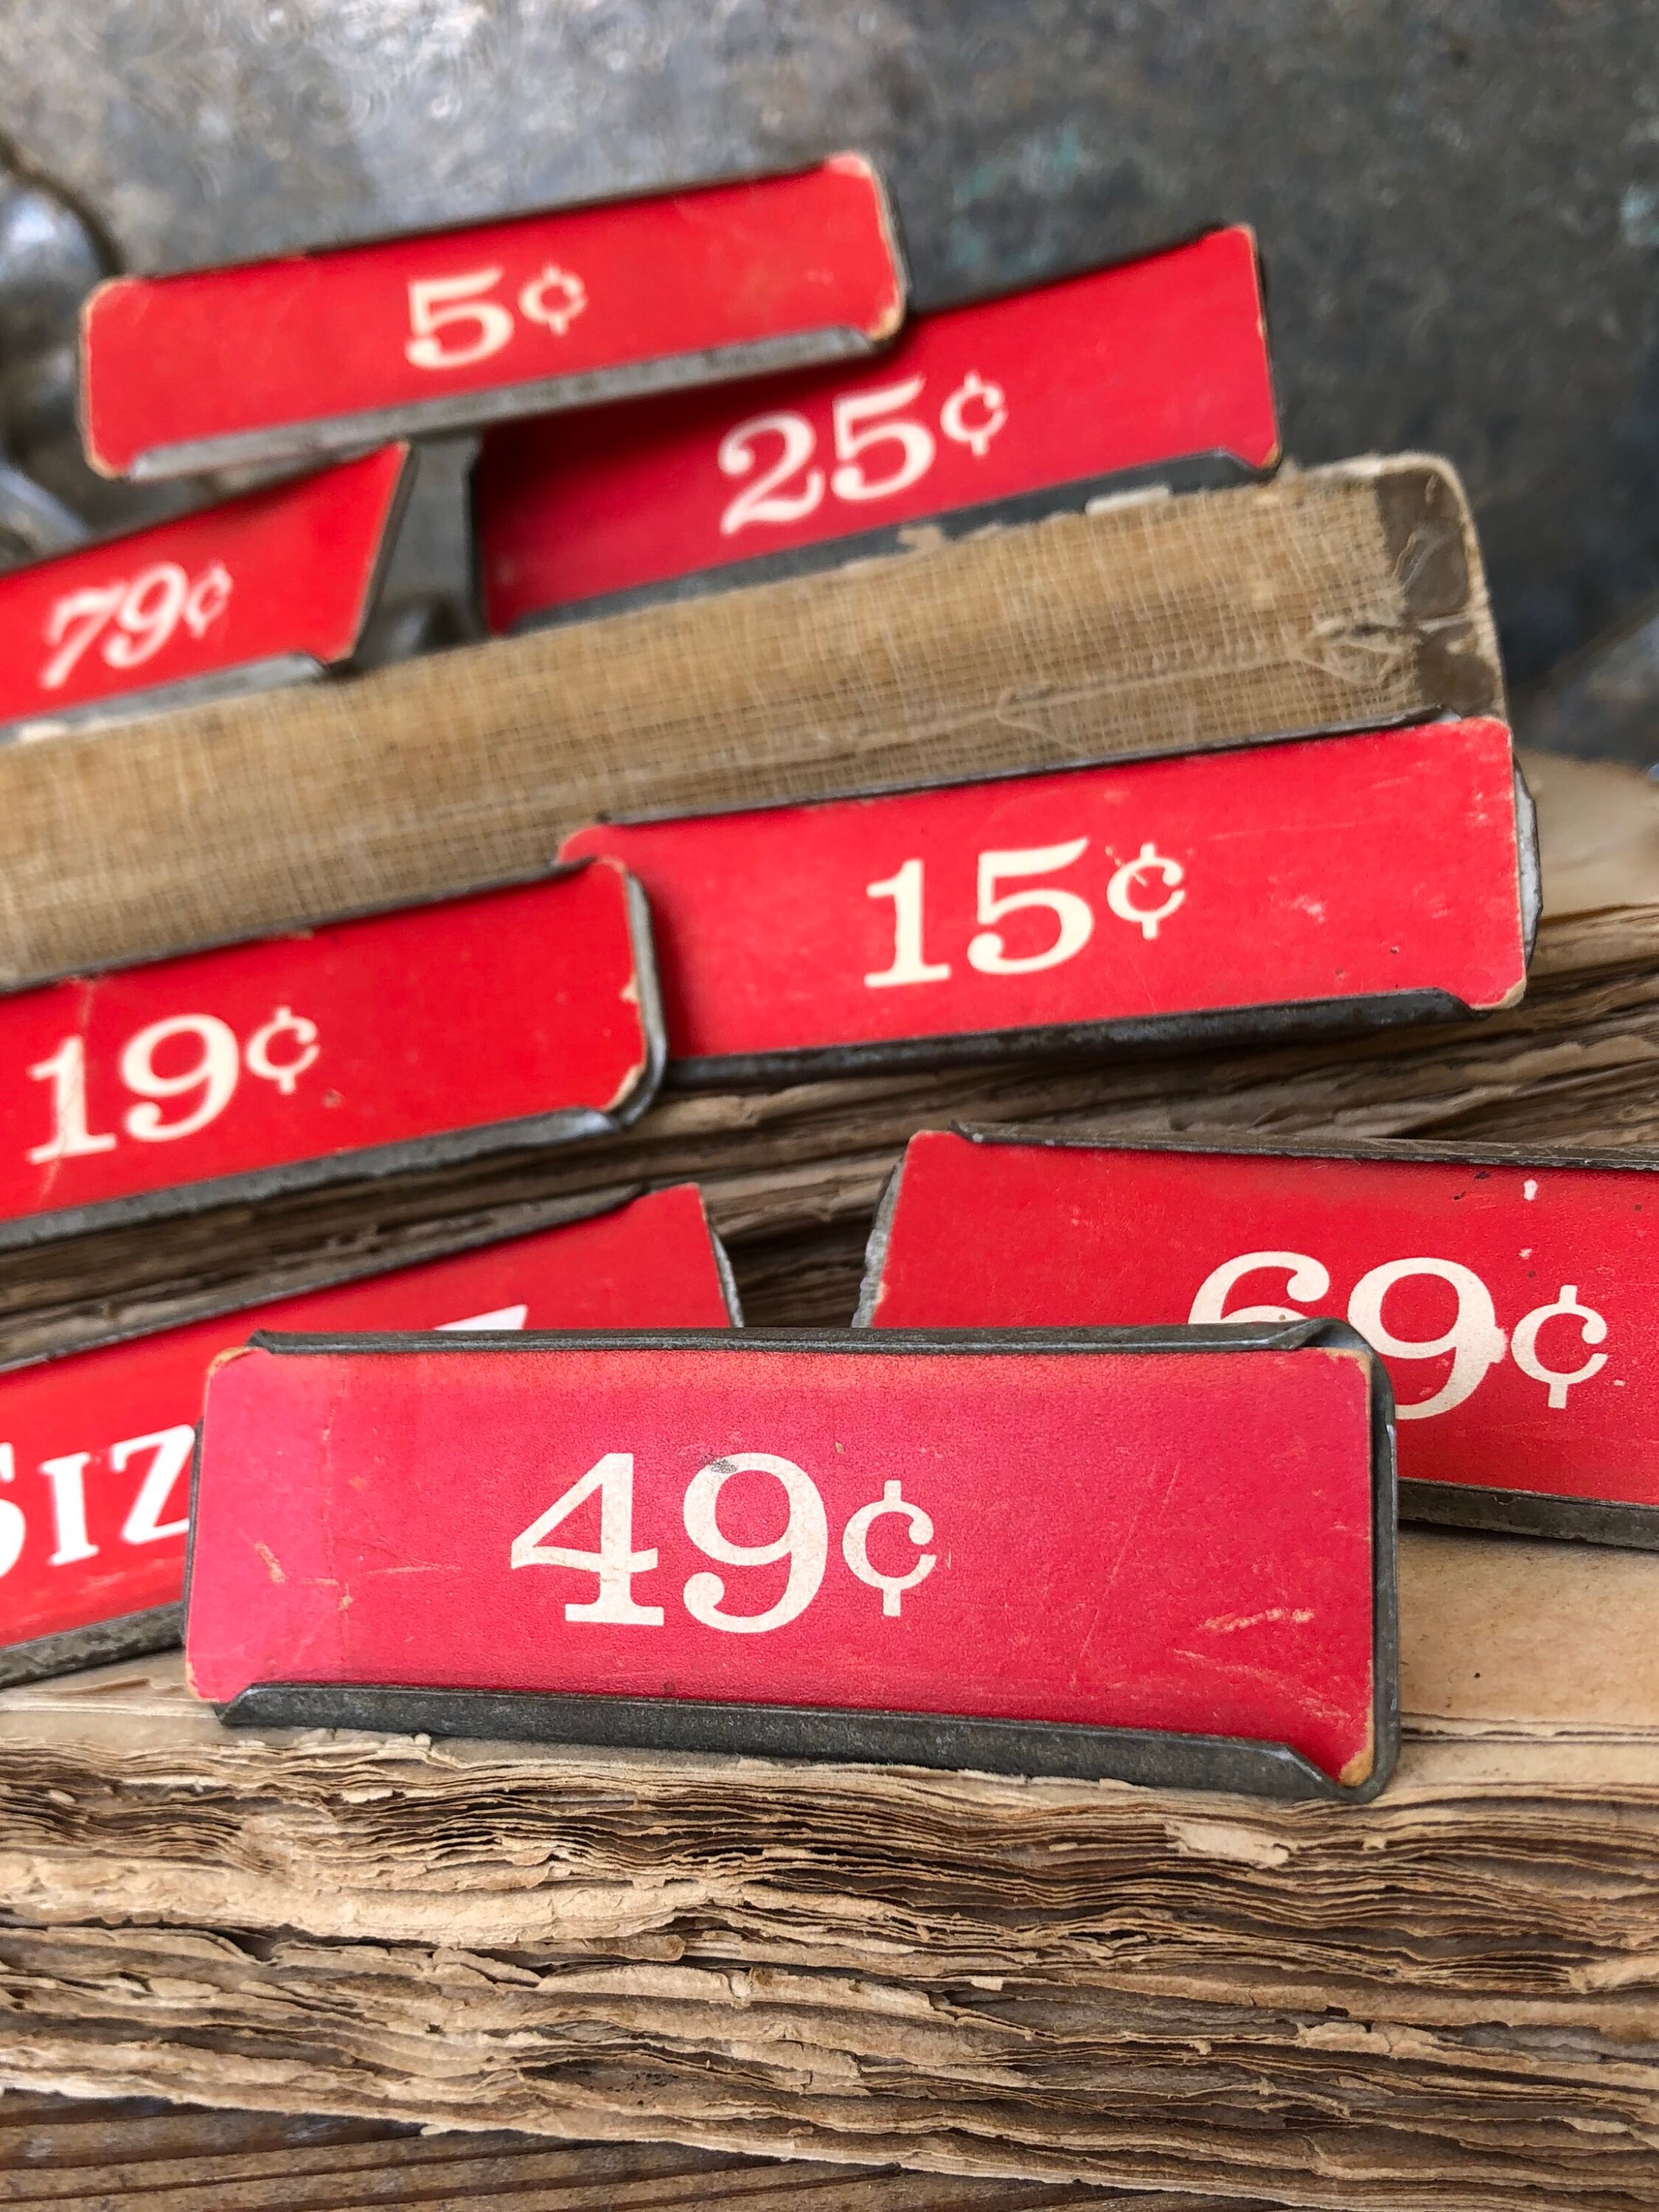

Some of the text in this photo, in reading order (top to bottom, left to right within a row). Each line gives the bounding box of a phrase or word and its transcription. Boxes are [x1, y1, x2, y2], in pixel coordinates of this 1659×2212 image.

[403, 262, 588, 370] 5¢
[717, 370, 1009, 537] 25¢
[40, 559, 234, 690] 79¢
[863, 835, 1188, 990] 15¢
[27, 1005, 321, 1165] 19¢
[509, 1451, 938, 1635] 49¢
